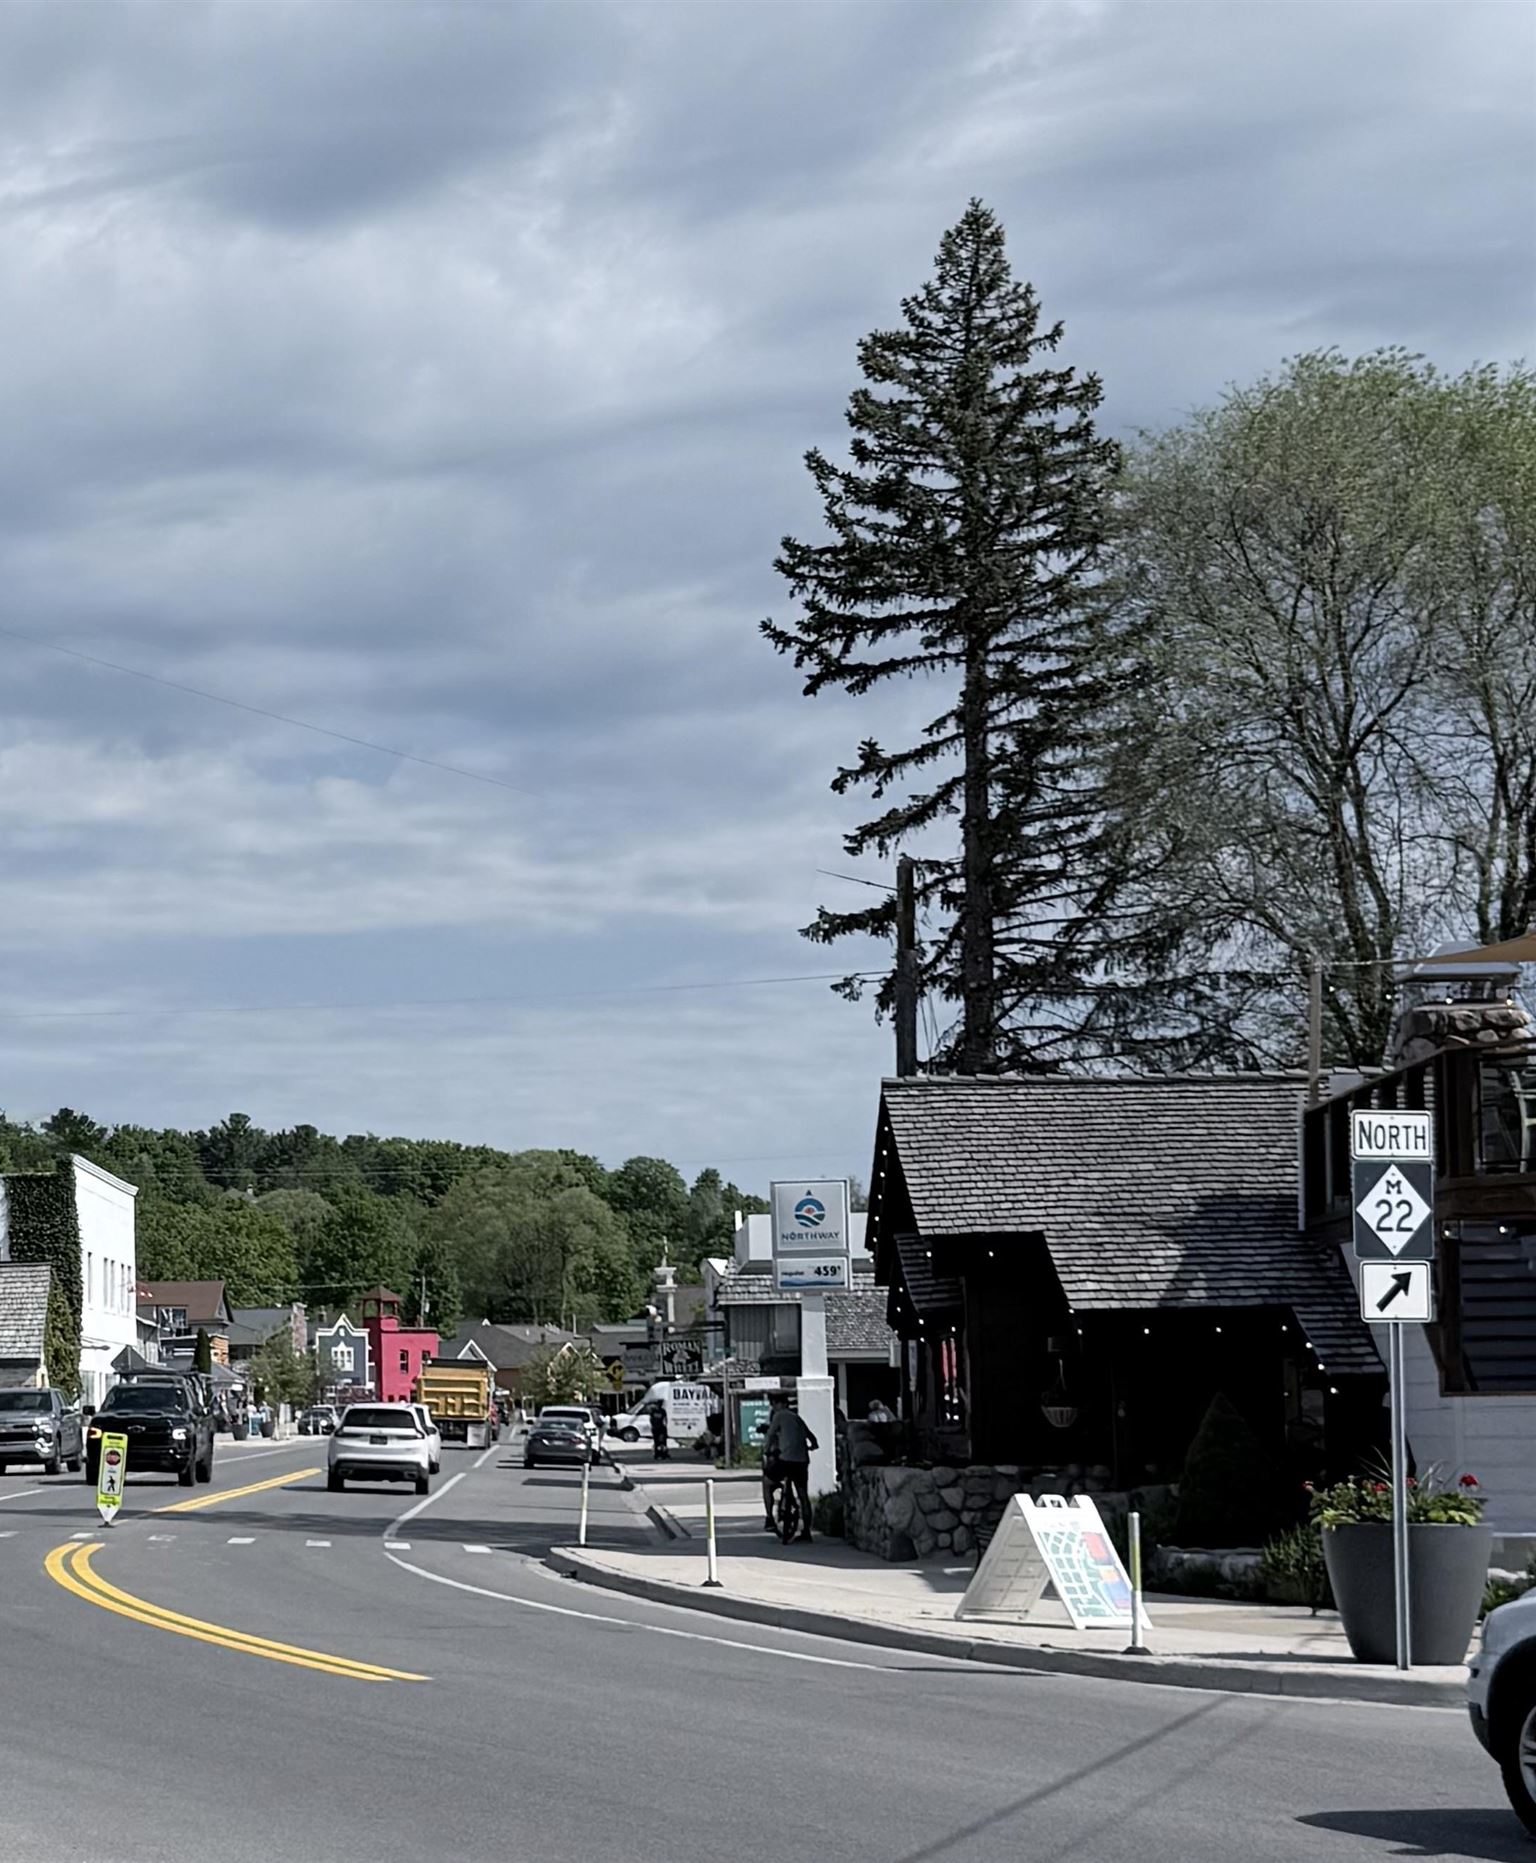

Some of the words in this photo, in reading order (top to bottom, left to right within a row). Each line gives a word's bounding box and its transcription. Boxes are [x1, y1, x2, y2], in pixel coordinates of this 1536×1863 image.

[1358, 1120, 1426, 1150] NORTH
[1385, 1179, 1403, 1195] M
[1374, 1198, 1415, 1232] 22
[781, 1231, 840, 1241] NORTHWAY
